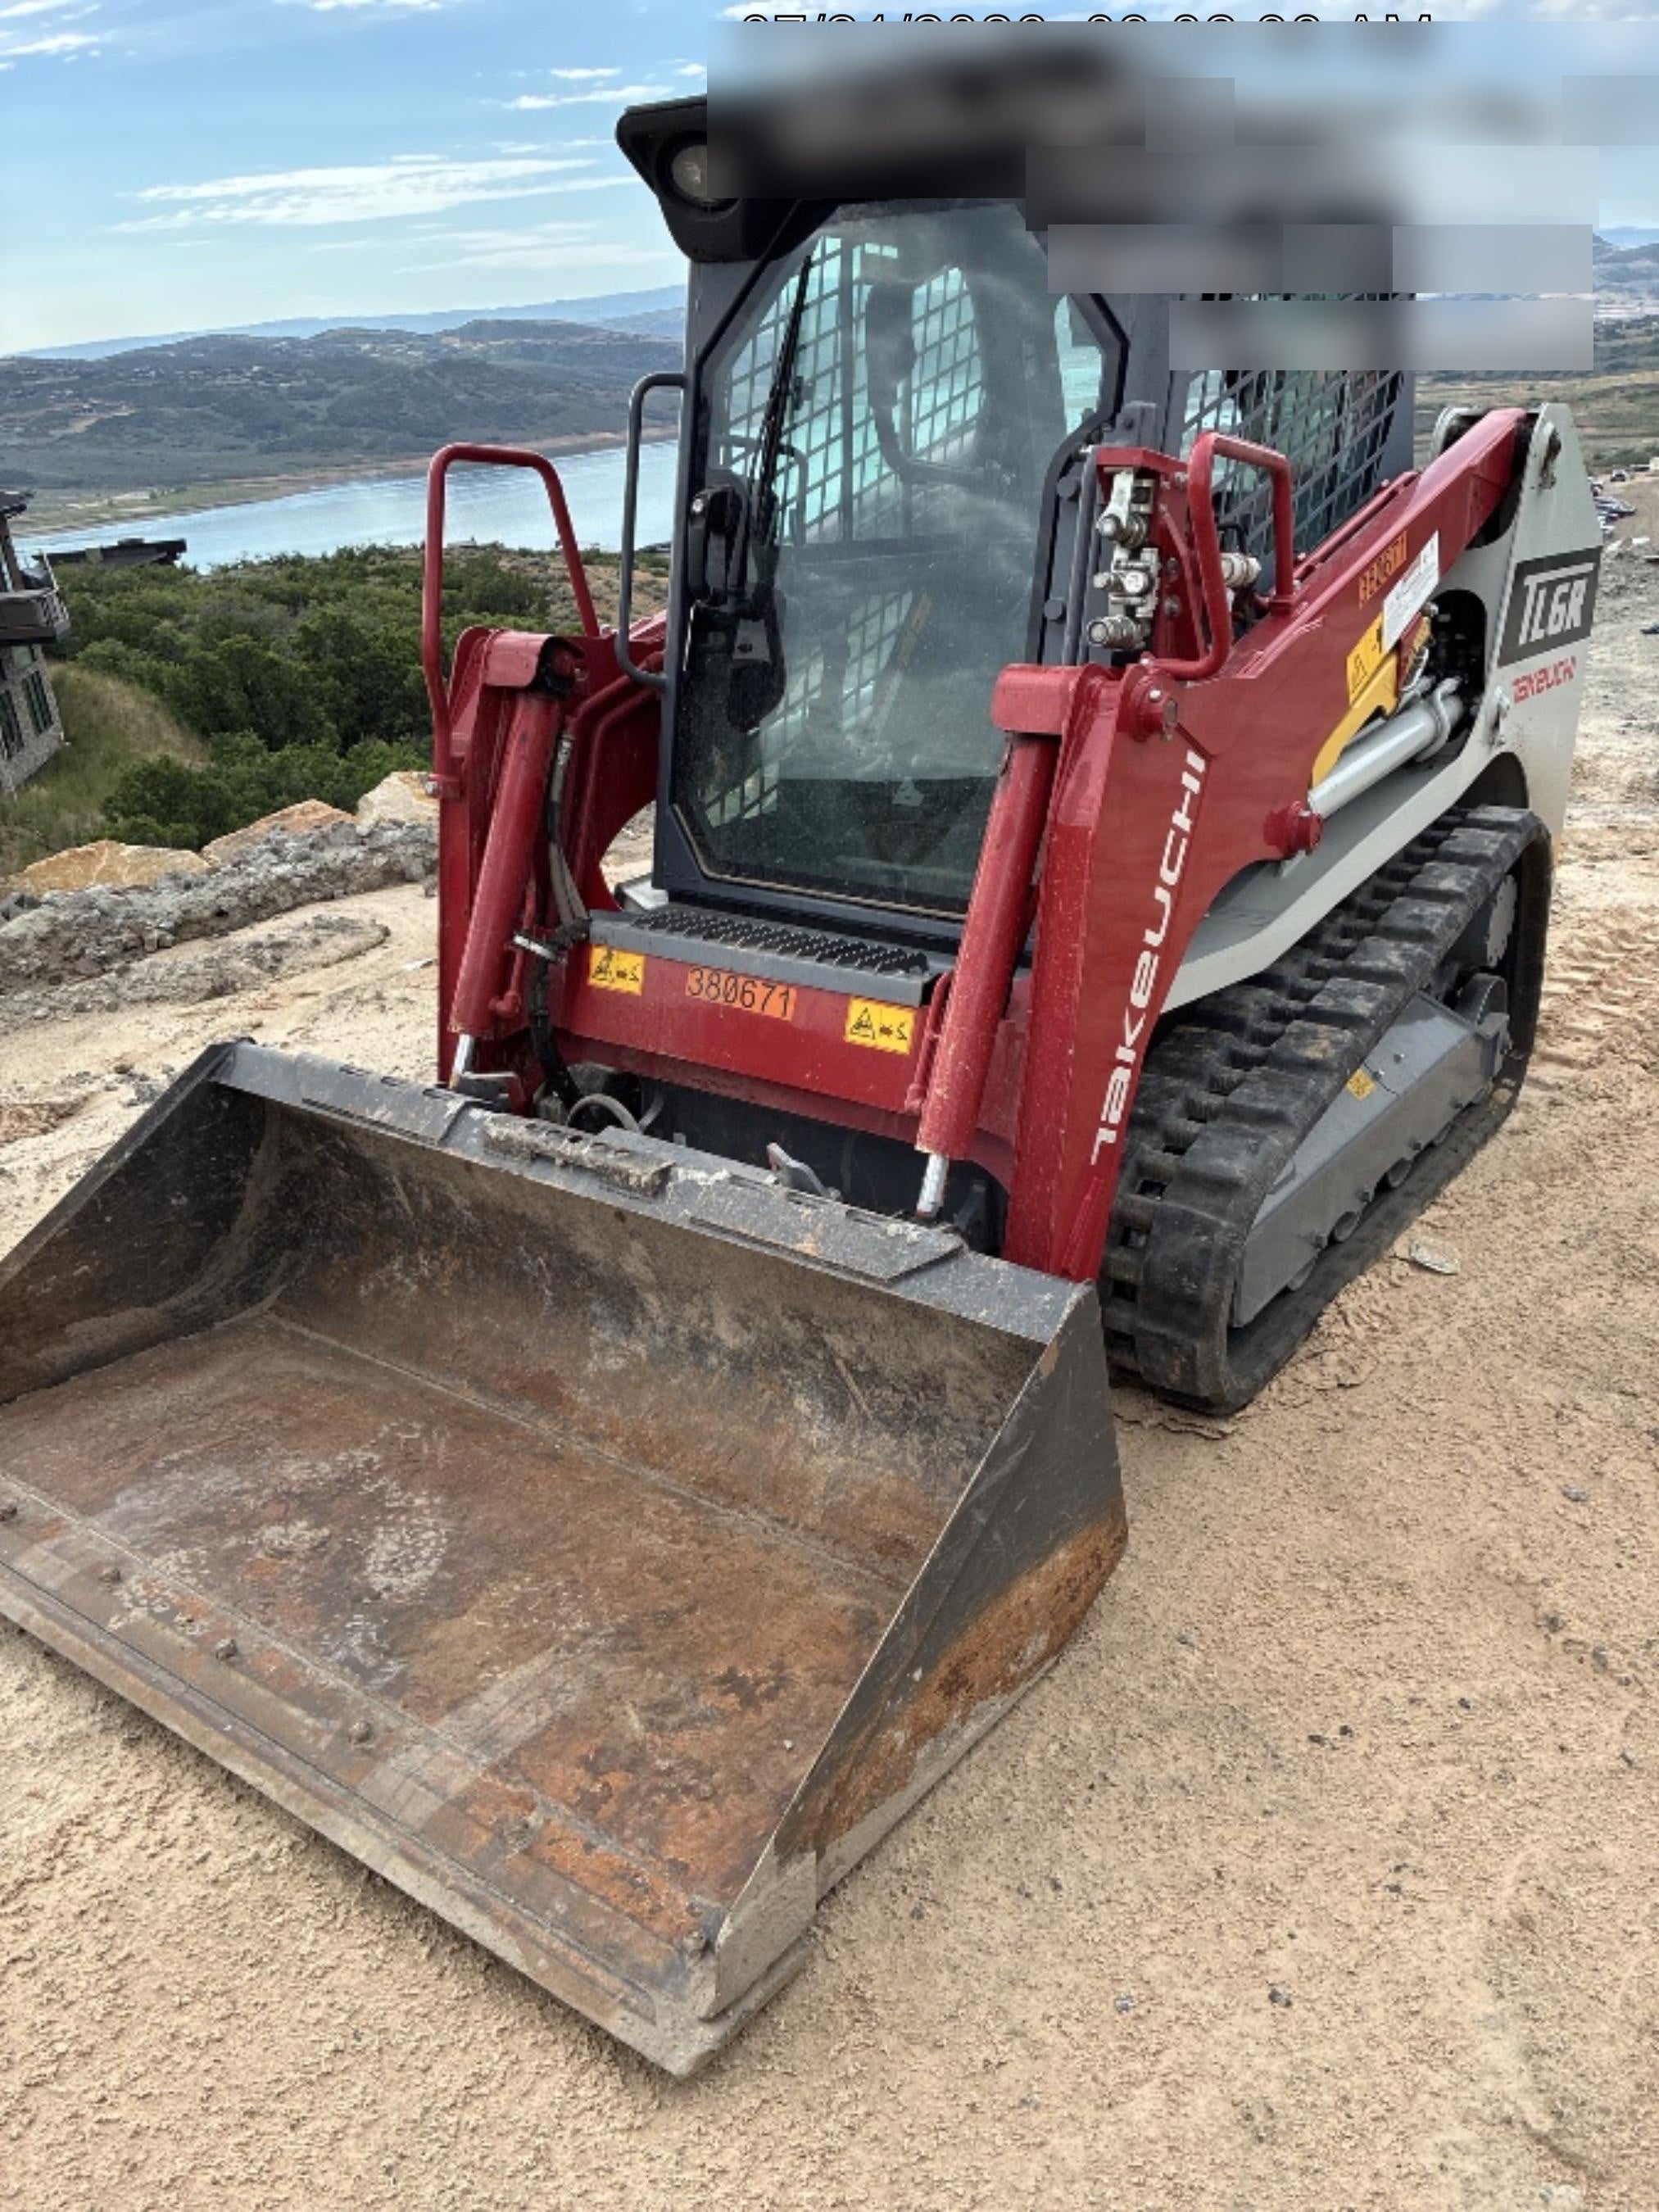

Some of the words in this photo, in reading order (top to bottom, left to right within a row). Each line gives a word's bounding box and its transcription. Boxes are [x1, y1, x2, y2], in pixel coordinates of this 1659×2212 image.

[1519, 563, 1594, 646] TL6R
[687, 968, 791, 1018] 380671
[1090, 750, 1206, 1166] TAKEUCHI
